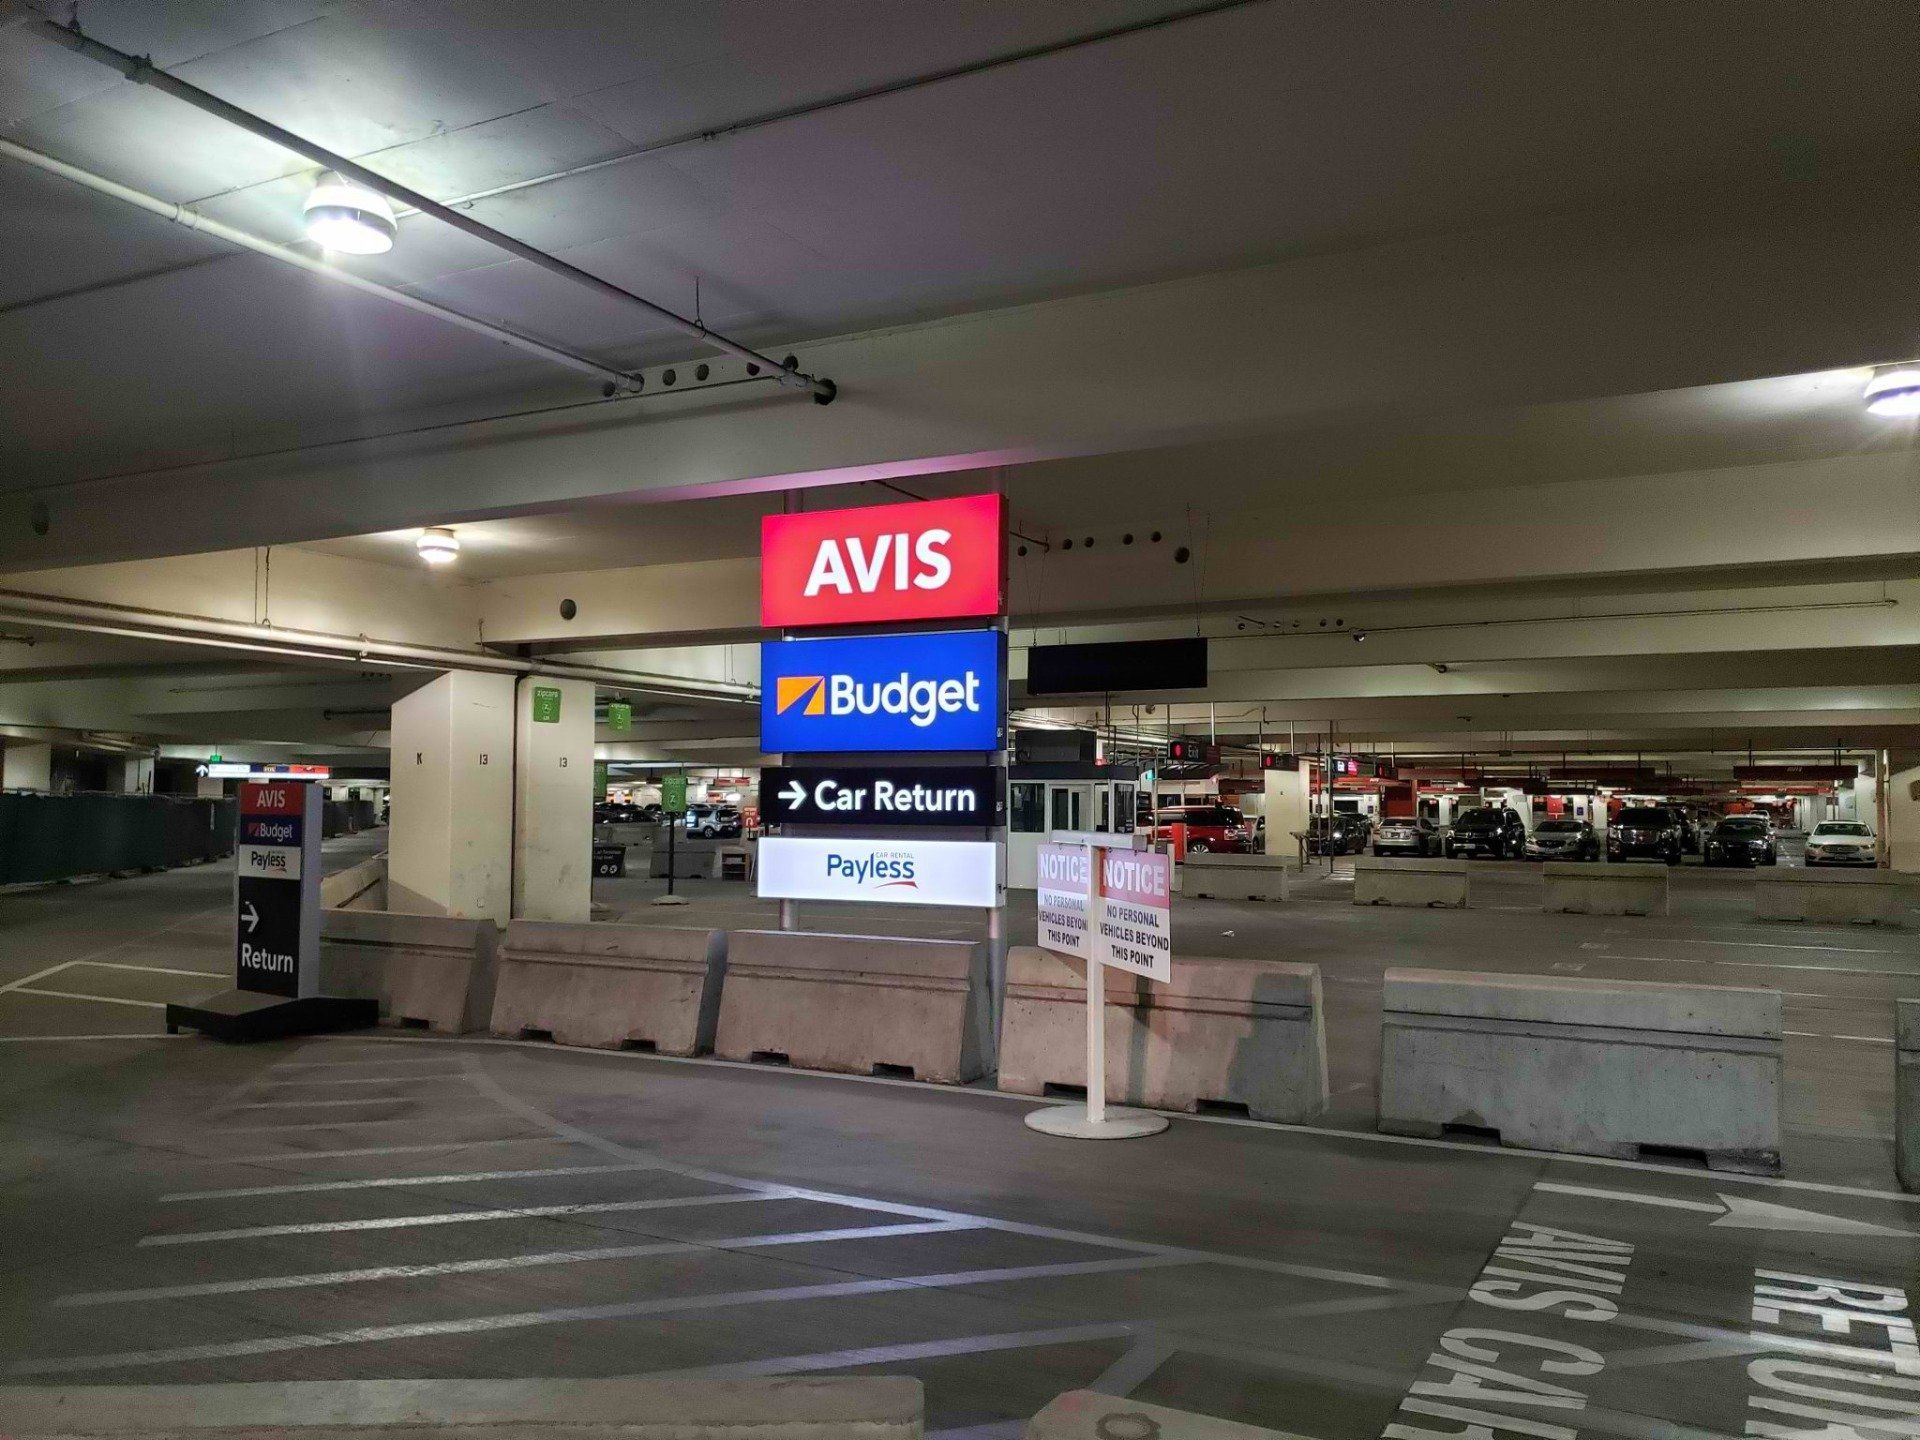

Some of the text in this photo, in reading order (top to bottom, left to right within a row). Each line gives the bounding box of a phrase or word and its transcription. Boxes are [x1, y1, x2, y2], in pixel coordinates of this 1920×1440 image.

[803, 528, 951, 597] AVIS
[831, 671, 979, 728] Budget
[417, 753, 423, 765] K
[480, 754, 489, 765] 13
[559, 757, 568, 768] 13
[256, 790, 286, 808] AVIS
[814, 780, 976, 812] Car Return
[260, 823, 293, 842] Budget
[251, 851, 286, 870] Payless
[827, 852, 915, 884] Payless
[1040, 853, 1089, 884] NOTICE
[1103, 859, 1165, 896] NOTICE
[1043, 894, 1084, 912] NO PERSONAL
[1039, 911, 1066, 927] VEHICLES
[1107, 905, 1160, 928] NO PERSONAL
[1048, 929, 1080, 948] THIS POINT
[1100, 922, 1169, 951] VEHICLES BEYOND
[241, 943, 294, 973] Return
[1111, 945, 1154, 969] THIS POINT
[1469, 1221, 1635, 1323] AVIS
